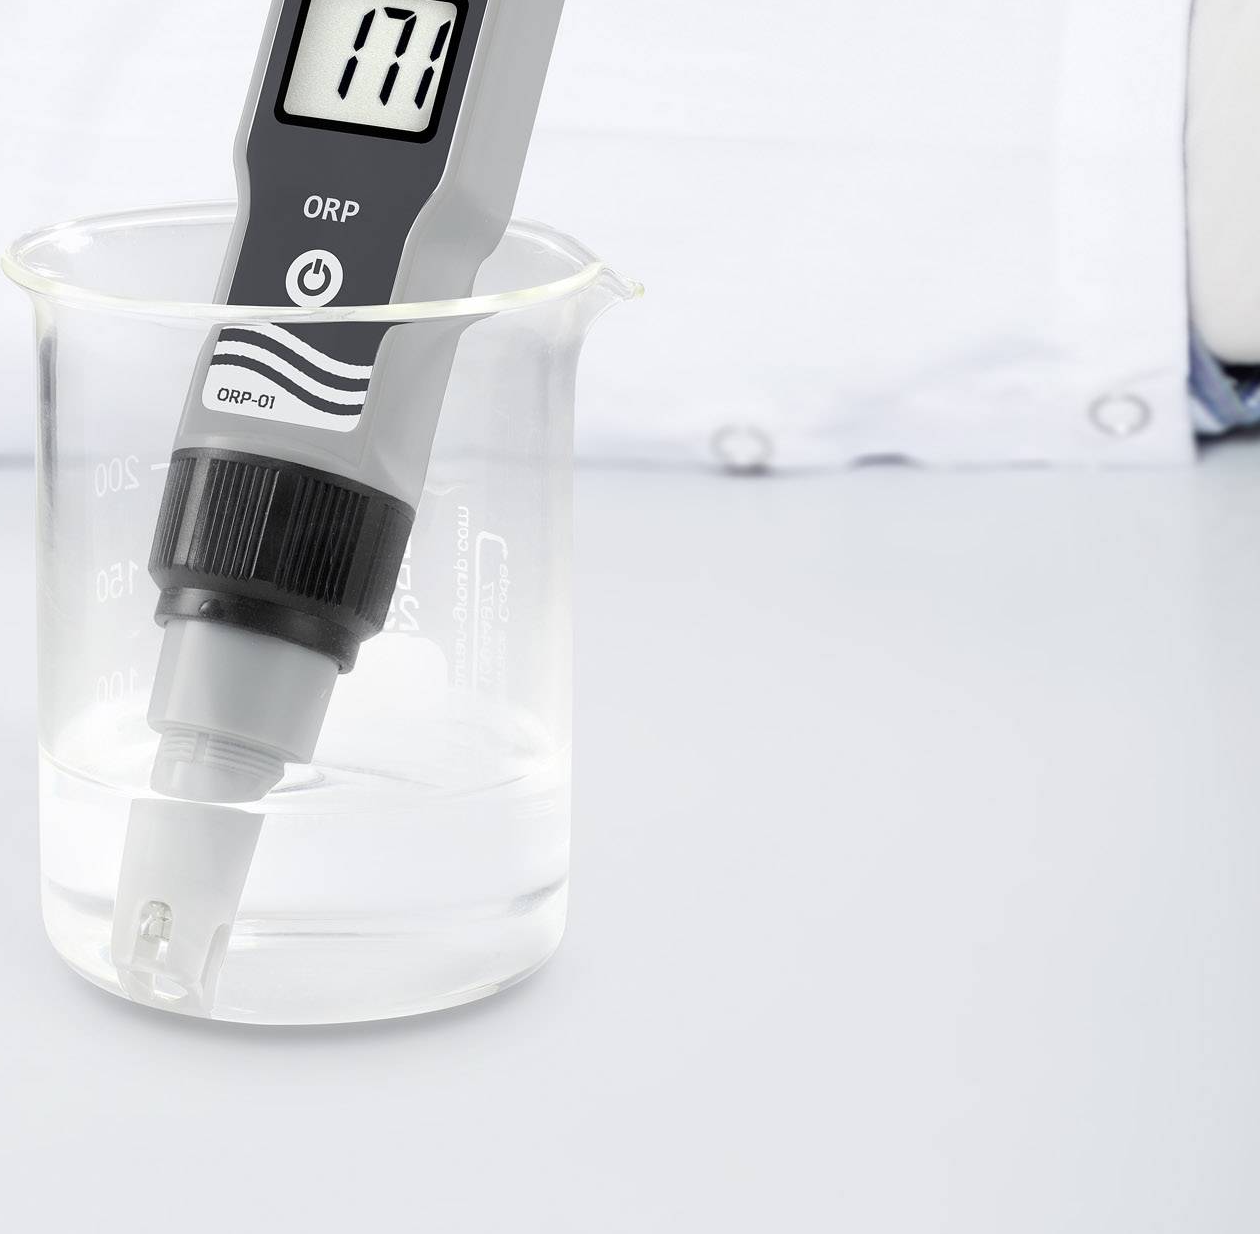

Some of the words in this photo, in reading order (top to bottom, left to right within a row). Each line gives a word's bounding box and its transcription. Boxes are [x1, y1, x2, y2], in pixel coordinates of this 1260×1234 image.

[338, 7, 451, 110] 171
[303, 195, 360, 223] ORP
[217, 388, 275, 409] ORP-01
